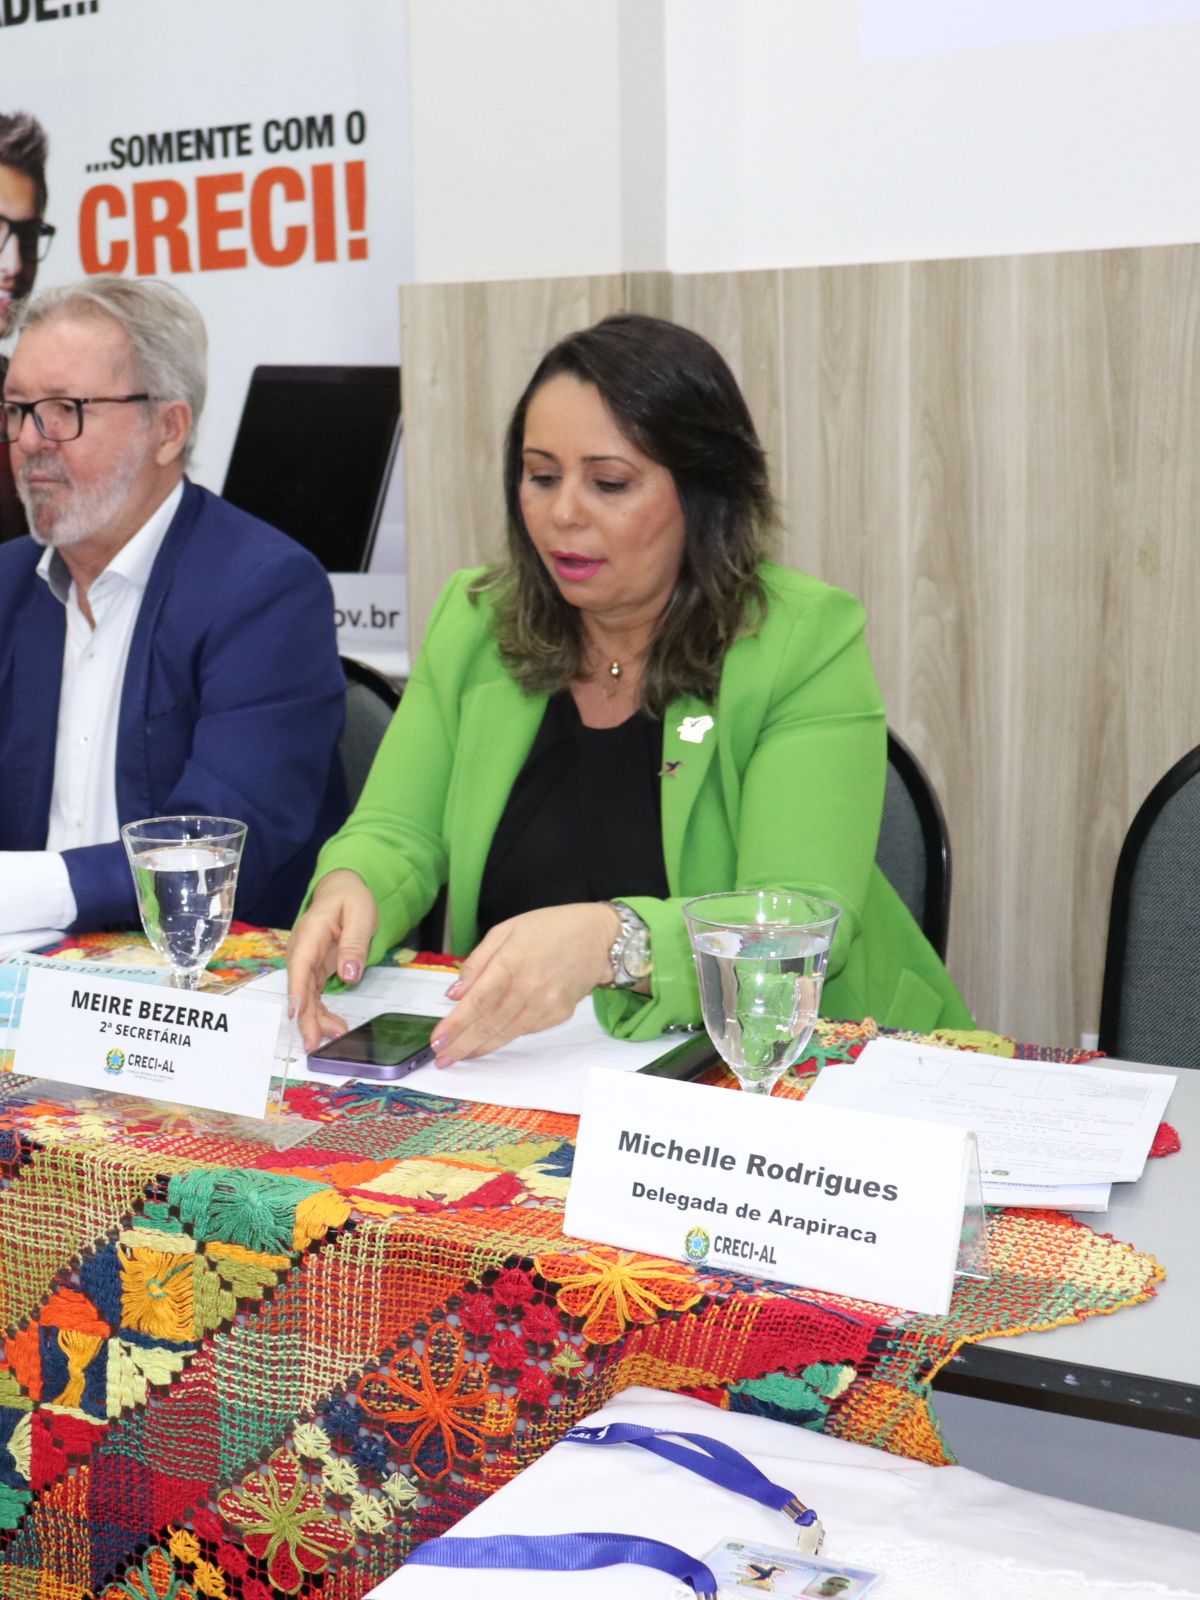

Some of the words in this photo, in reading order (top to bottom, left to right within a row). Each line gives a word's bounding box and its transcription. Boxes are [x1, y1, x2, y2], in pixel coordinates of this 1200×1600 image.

[85, 123, 253, 173] ...SOMENTE
[263, 114, 335, 155] COM
[346, 110, 367, 146] O
[77, 160, 370, 279] CRECI!
[335, 604, 400, 629] ov.br
[71, 990, 133, 1018] MEIRE
[138, 1000, 229, 1033] BEZERRA
[115, 1022, 192, 1048] SECRETÁRIA
[128, 1054, 175, 1073] CRECI-AL
[618, 1130, 736, 1171] Michelle
[746, 1154, 899, 1201] Rodrigues
[632, 1182, 728, 1214] Delegada
[736, 1202, 761, 1222] de
[768, 1209, 877, 1245] Arapiraca
[714, 1235, 777, 1265] CRECI-AL
